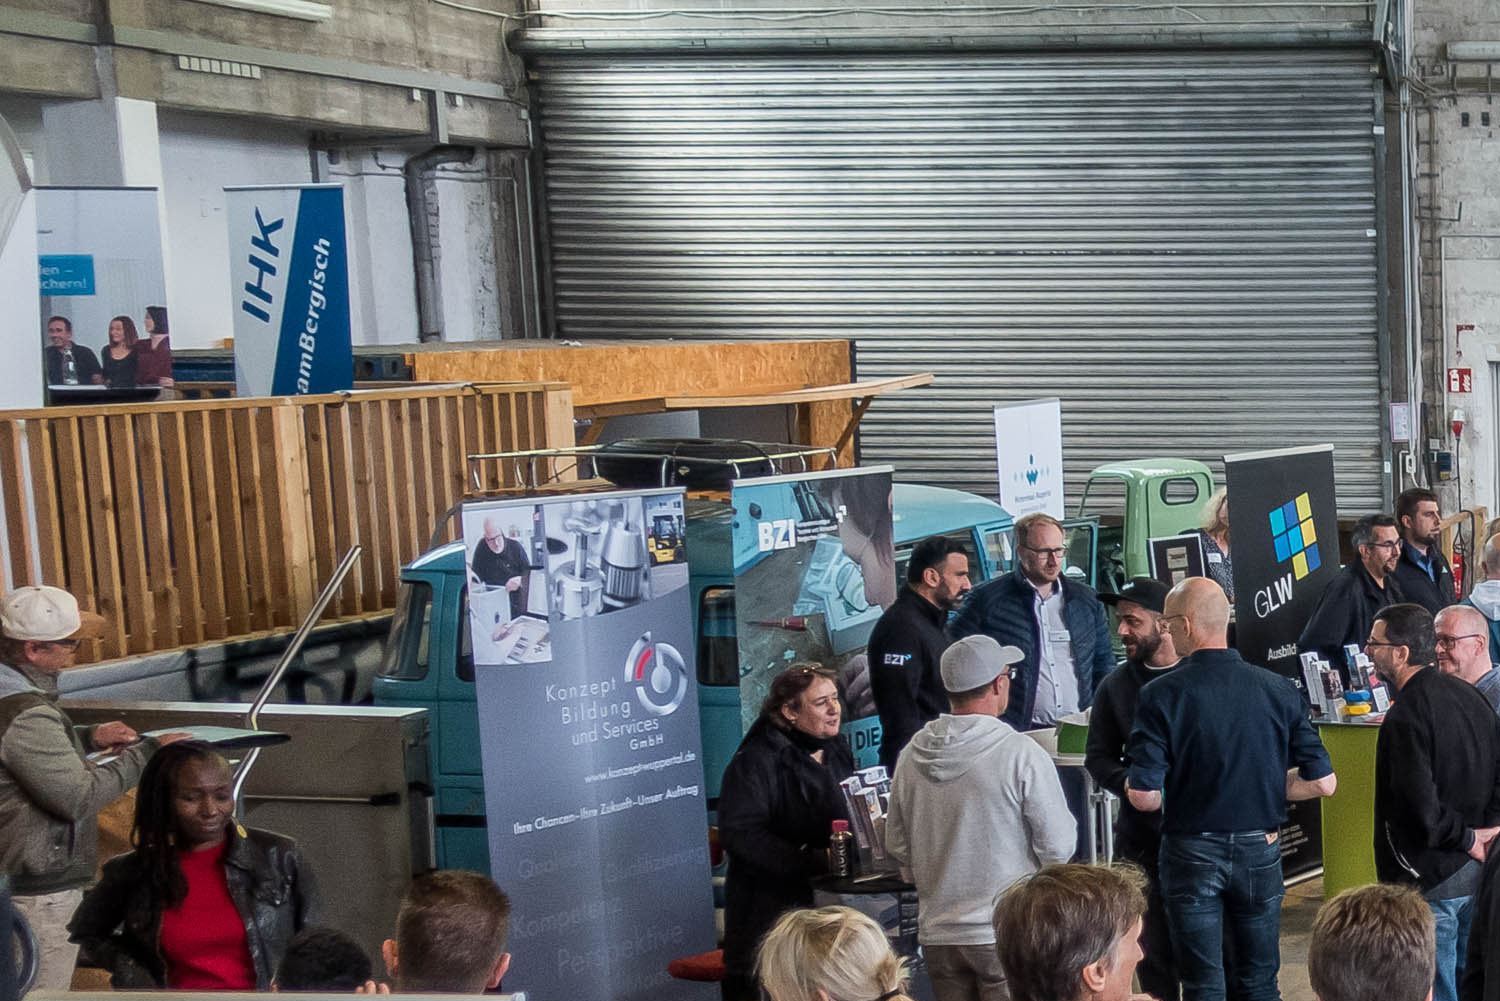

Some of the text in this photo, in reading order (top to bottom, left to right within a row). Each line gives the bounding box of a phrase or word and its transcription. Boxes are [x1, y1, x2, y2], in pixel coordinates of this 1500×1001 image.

[241, 206, 285, 324] IHK
[296, 237, 331, 396] amBergisch
[758, 519, 796, 552] BZI
[1254, 573, 1294, 618] GLW
[1267, 641, 1297, 661] Ausbild
[545, 676, 617, 703] Konzept
[561, 700, 631, 725] Bildung
[571, 717, 660, 746] und Services
[629, 733, 664, 750] GmbH
[513, 821, 533, 836] Ihre
[664, 783, 700, 801] Auftrag
